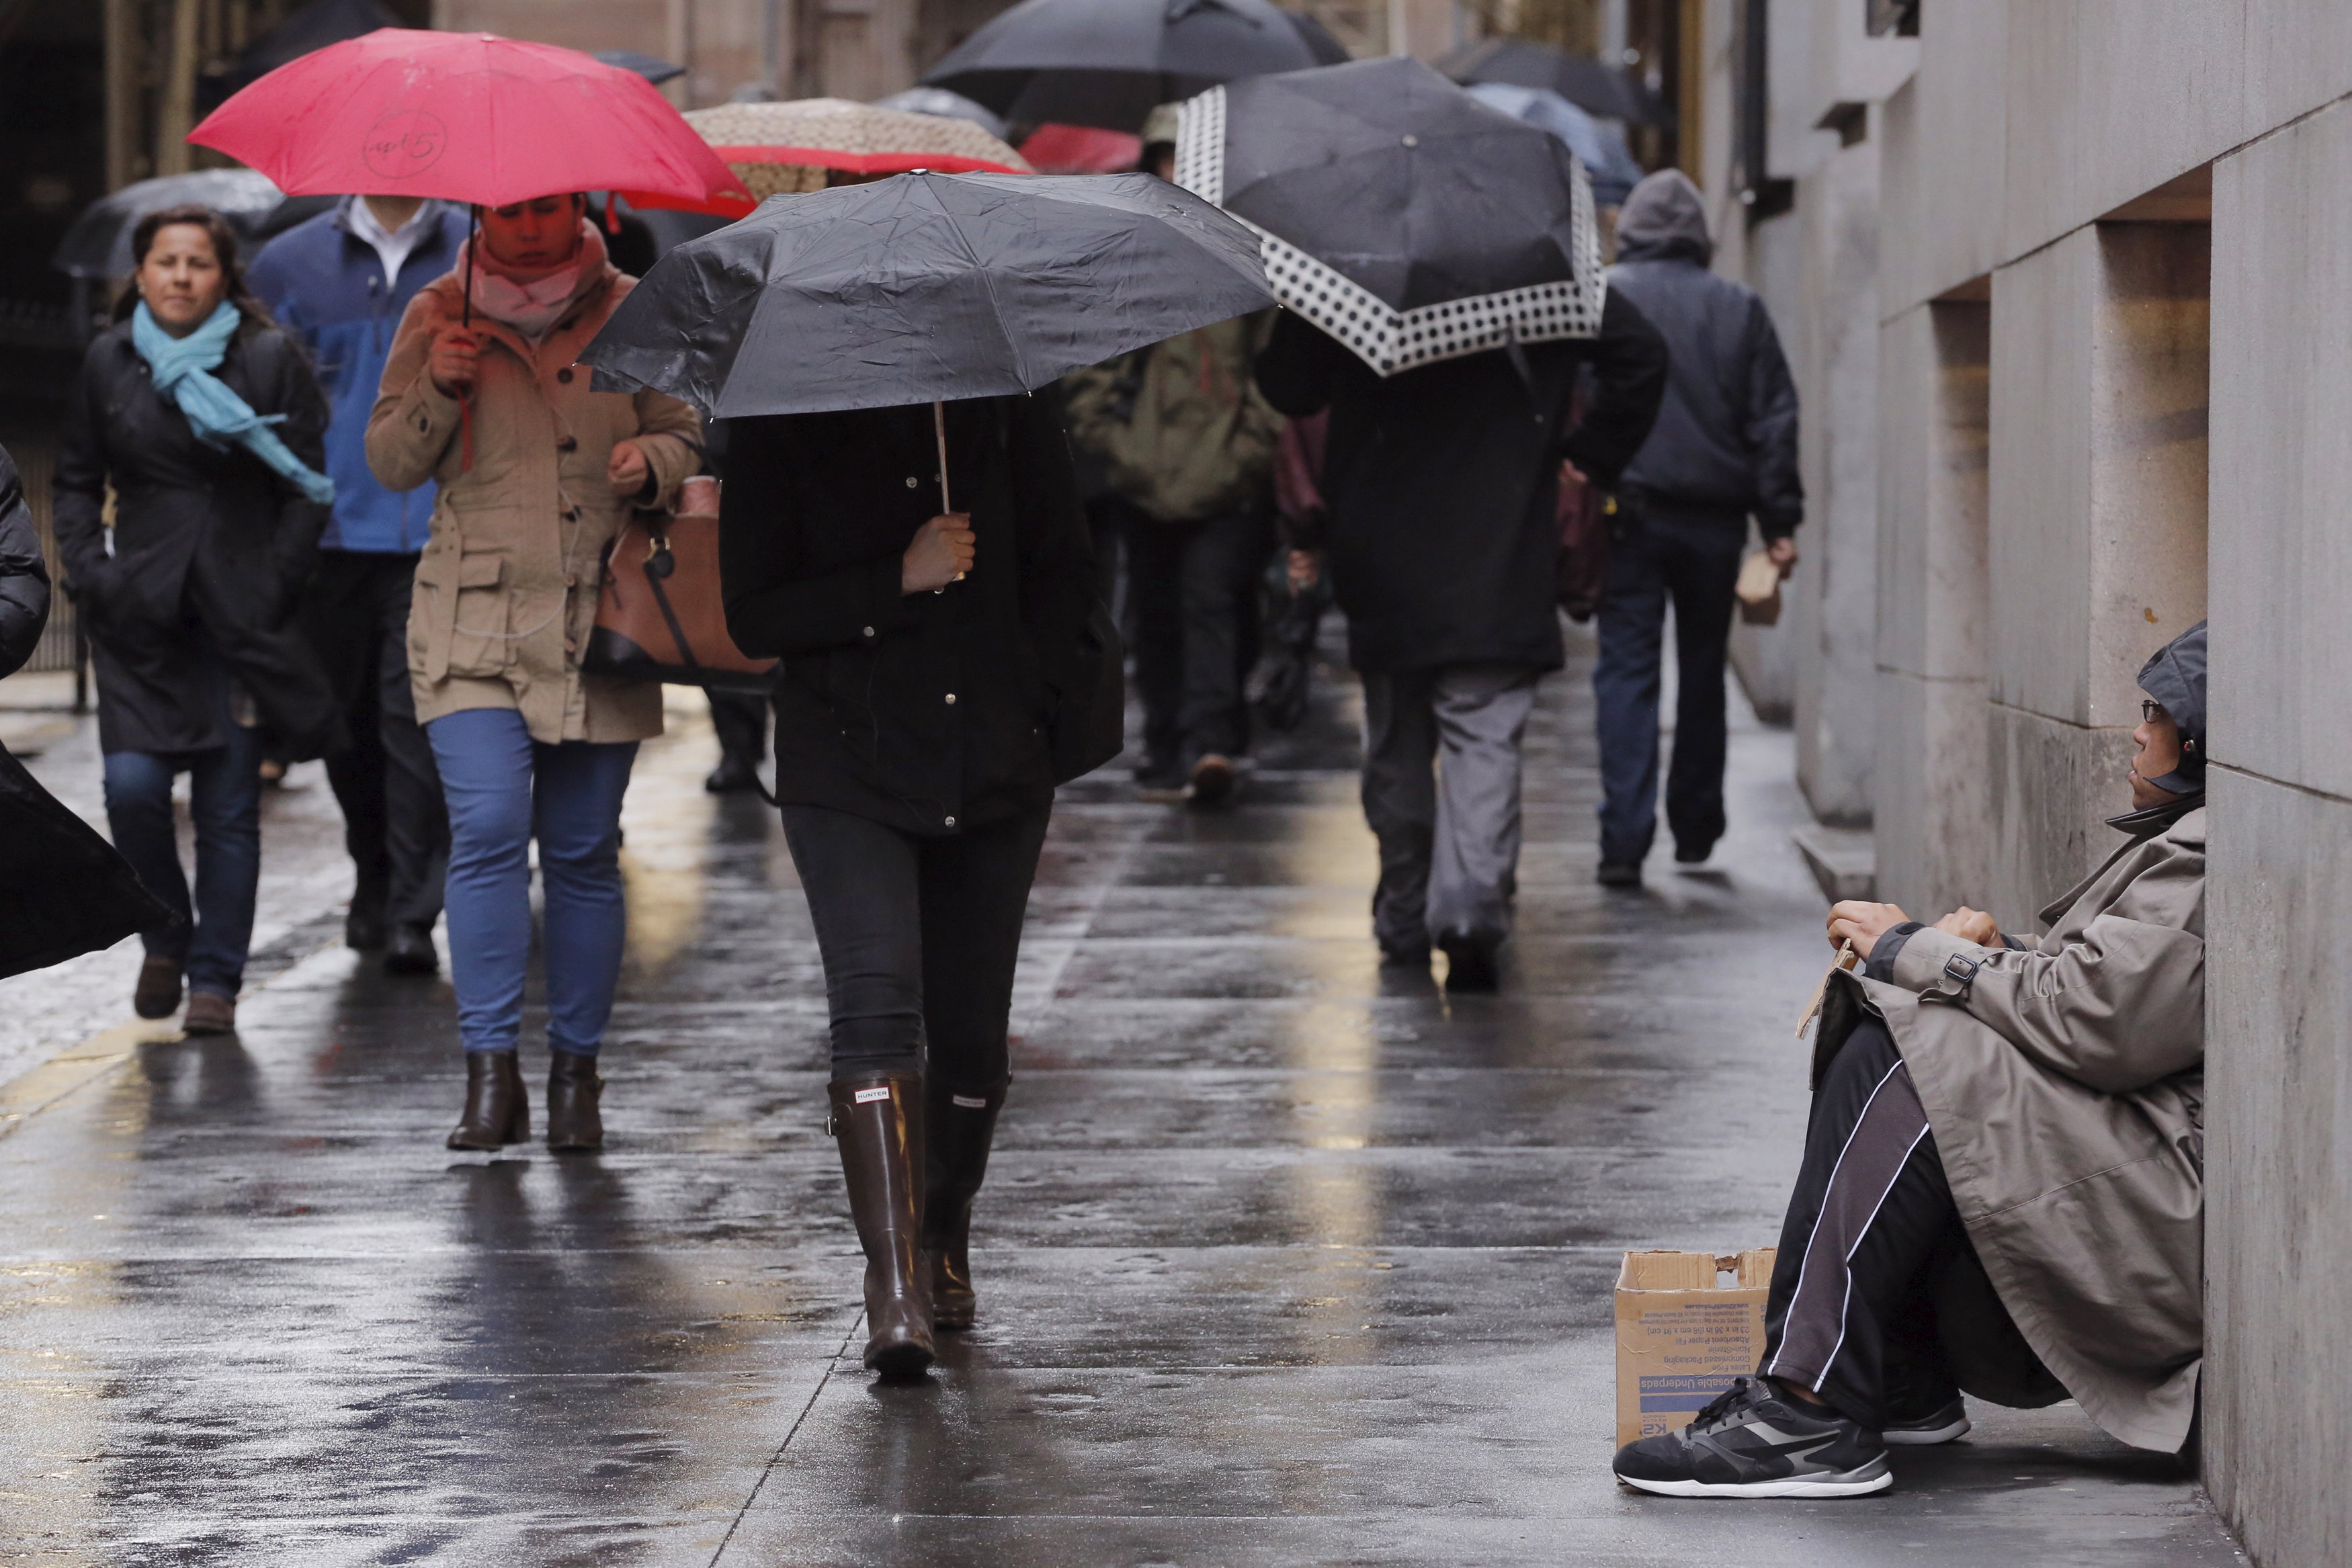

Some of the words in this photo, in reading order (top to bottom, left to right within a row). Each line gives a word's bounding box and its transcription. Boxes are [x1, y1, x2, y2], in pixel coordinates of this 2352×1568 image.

[857, 1090, 888, 1100] HUNTER
[1647, 1327, 1661, 1336] cm)
[1689, 1336, 1710, 1345] Paper
[1712, 1336, 1751, 1344] Absorbent
[1663, 1355, 1702, 1364] Packaging
[1641, 1378, 1695, 1389] Underpads
